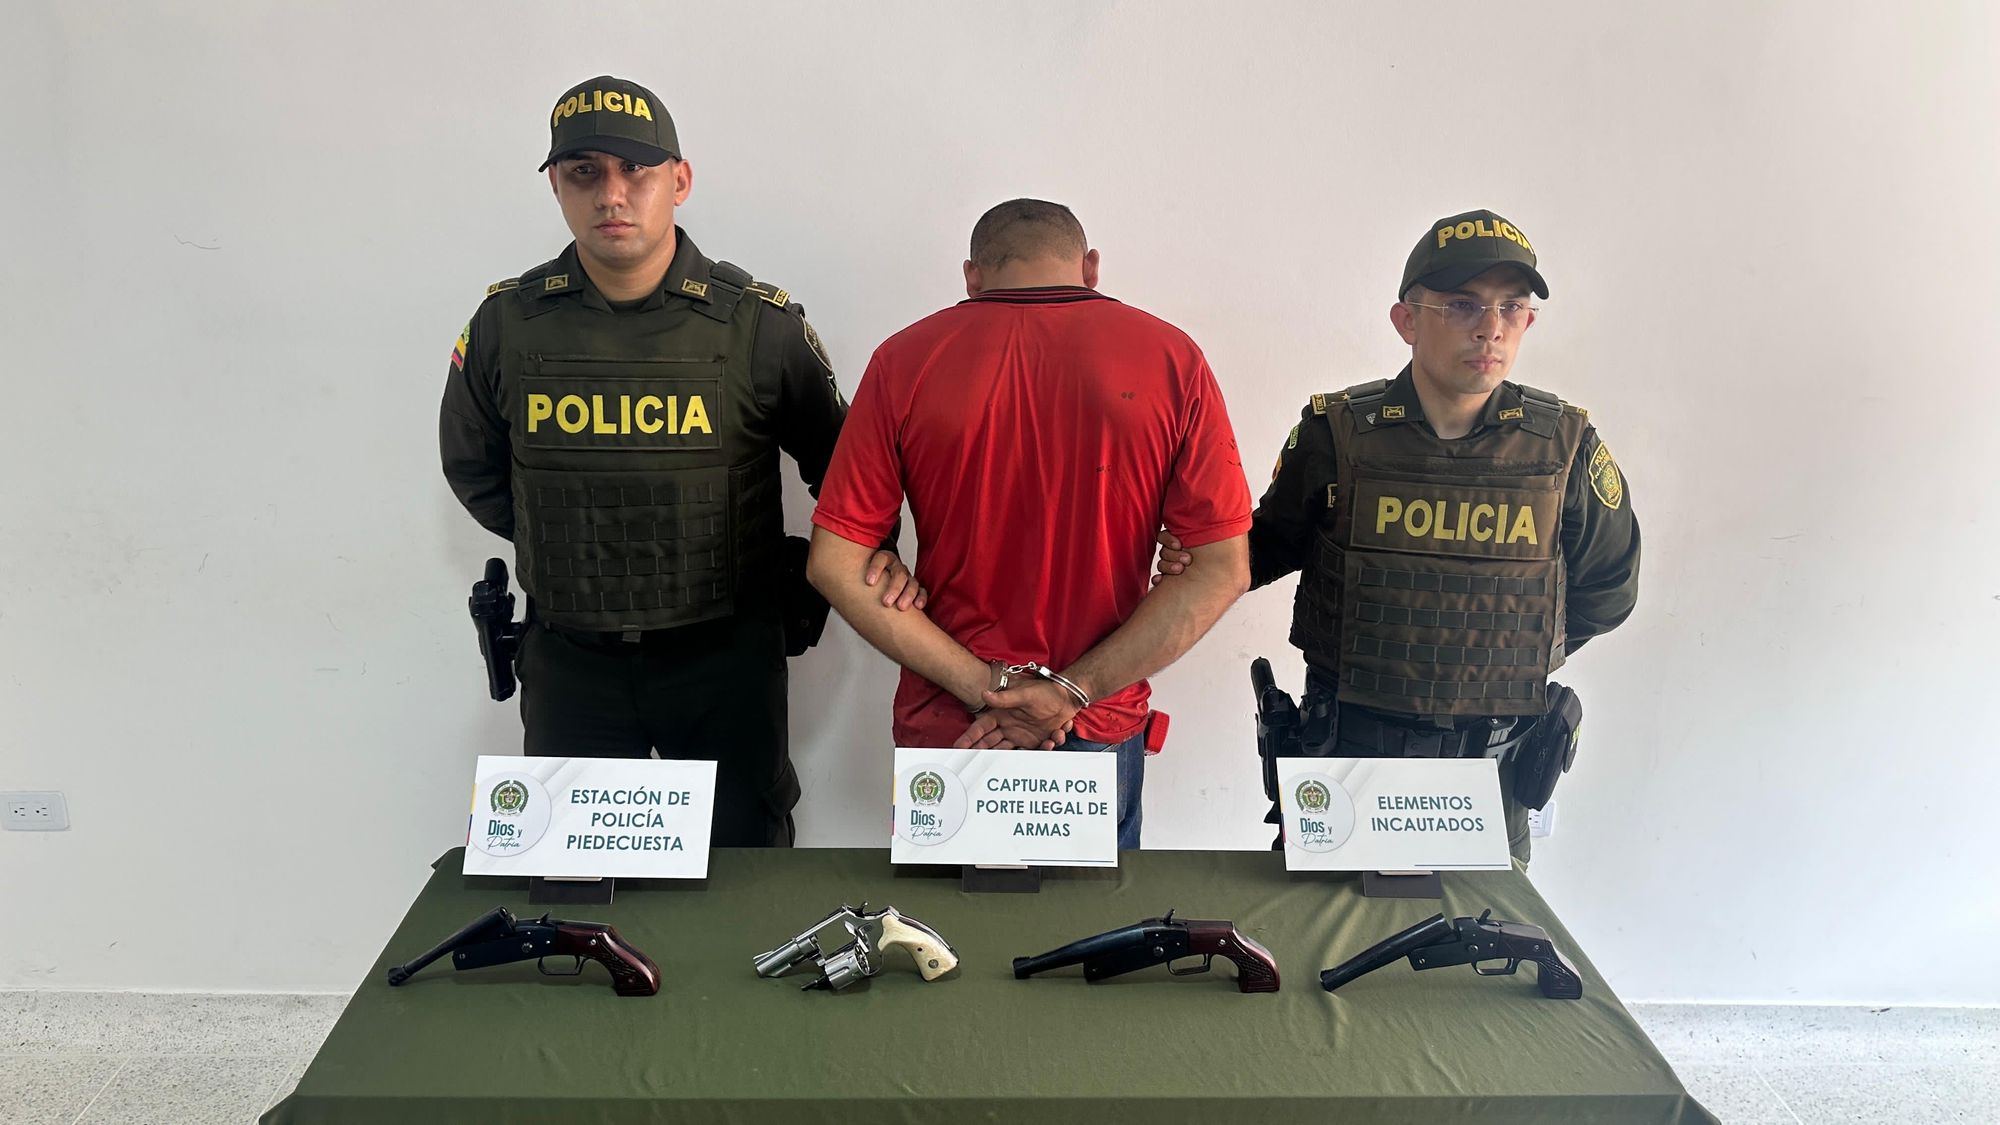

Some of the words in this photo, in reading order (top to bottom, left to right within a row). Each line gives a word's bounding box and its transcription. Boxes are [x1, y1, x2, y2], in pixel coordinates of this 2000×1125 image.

[552, 89, 654, 127] POLICIA
[527, 393, 713, 435] POLICIA
[1376, 496, 1538, 545] POLICIA
[986, 777, 1060, 793] CAPTURA
[1065, 779, 1097, 794] POR
[570, 785, 662, 806] ESTACIÓN
[667, 791, 691, 806] DE
[1377, 795, 1473, 811] ELEMENTOS
[976, 799, 1025, 814] PORTE
[1029, 800, 1084, 815] ILEGAL
[1088, 801, 1108, 816] DE
[591, 808, 665, 828] POLICÍA
[910, 809, 936, 826] Dios
[938, 819, 943, 828] y
[1299, 817, 1325, 833] Dios
[1327, 826, 1333, 835] y
[1371, 817, 1485, 832] INCAUTADOS
[487, 819, 515, 836] Dios
[517, 828, 523, 838] y
[910, 825, 943, 840] Patria
[1012, 822, 1071, 837] ARMAS
[486, 835, 521, 851] Patria
[566, 834, 684, 852] PIEDECUESTA
[1301, 832, 1333, 847] Patria
